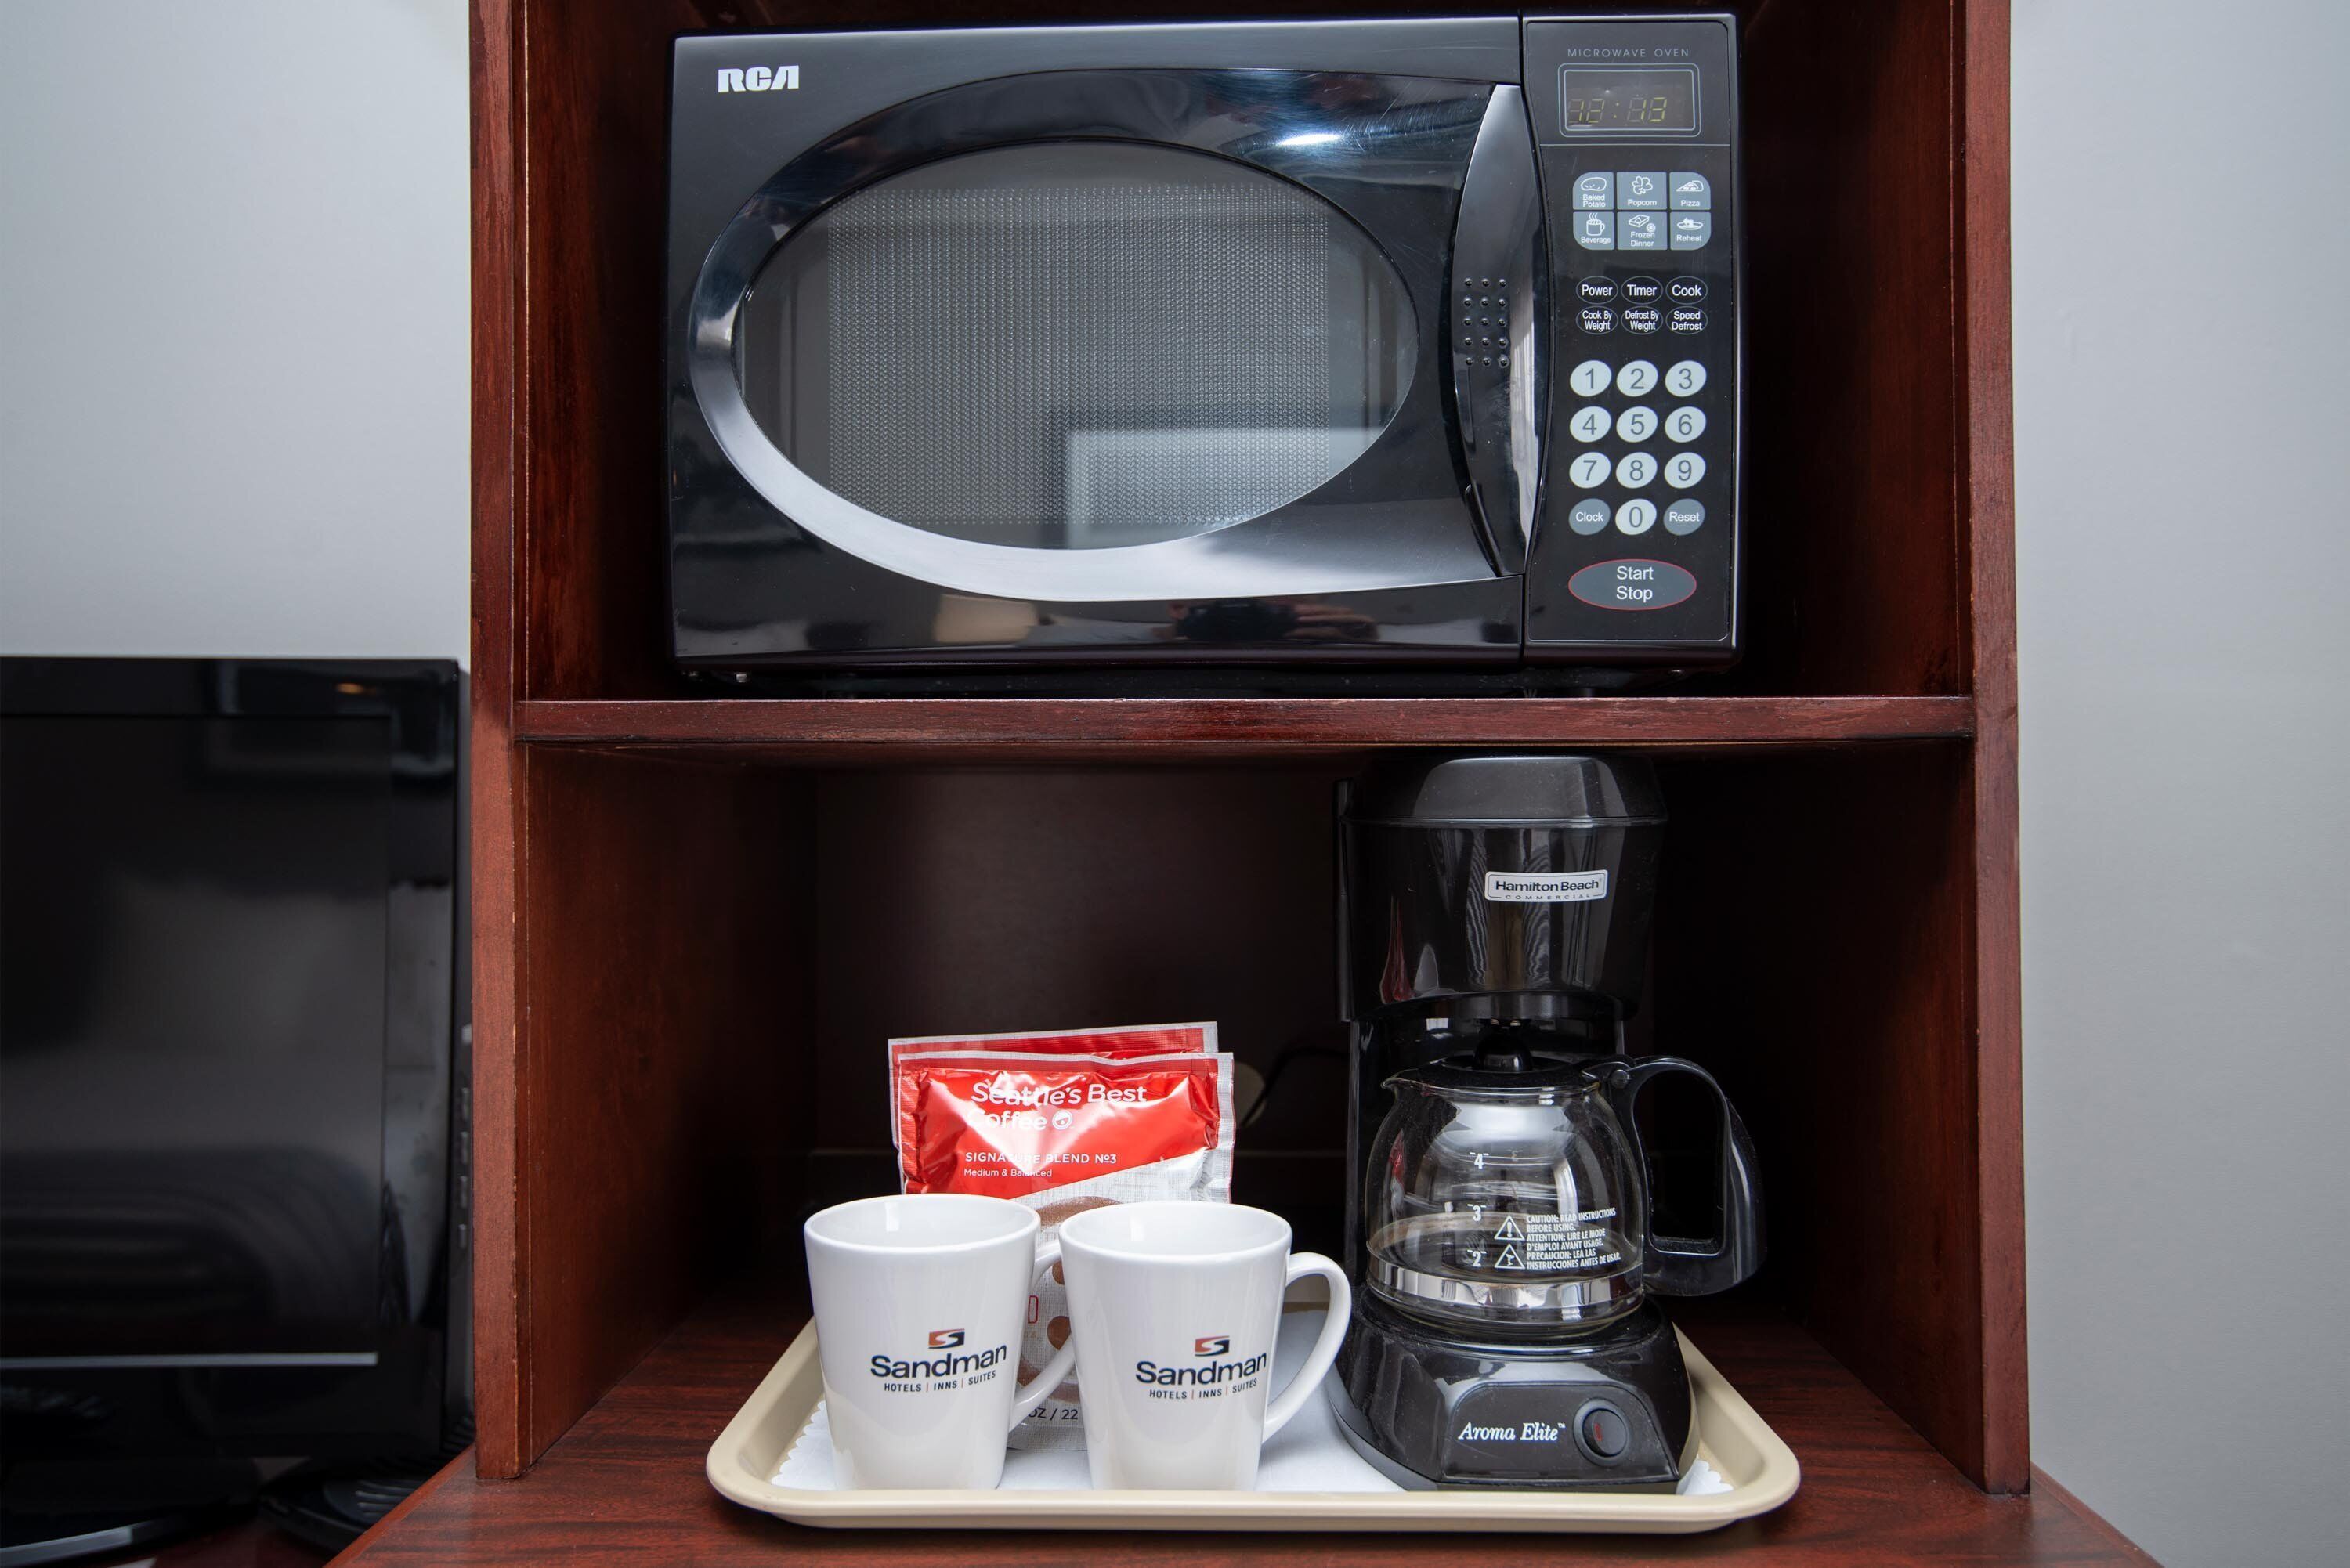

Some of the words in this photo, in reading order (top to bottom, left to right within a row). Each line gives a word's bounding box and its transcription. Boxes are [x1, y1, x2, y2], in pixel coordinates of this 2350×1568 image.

[1567, 49, 1646, 57] MICROWAVE
[1654, 48, 1689, 57] OVEN
[718, 65, 799, 92] RCA
[1627, 199, 1657, 208] Popcorn
[1581, 236, 1611, 244] Beverage
[1582, 284, 1614, 296] Power
[1626, 284, 1658, 296] Timer
[1672, 284, 1702, 296] Cook
[1582, 310, 1602, 320] Cook
[1603, 310, 1612, 320] By
[1625, 310, 1650, 320] Defrost
[1650, 310, 1659, 321] By
[1673, 311, 1701, 321] Speed
[1585, 320, 1611, 332] Weight
[1630, 320, 1656, 332] Weight
[1672, 321, 1703, 331] Defrost
[1585, 368, 1595, 389] 1
[1630, 368, 1644, 389] 2
[1679, 368, 1693, 389] 3
[1582, 414, 1597, 435] 4
[1631, 414, 1645, 435] 5
[1678, 414, 1692, 435] 6
[1583, 461, 1597, 481] 7
[1629, 460, 1643, 481] 8
[1678, 460, 1692, 481] 9
[1575, 511, 1604, 522] Clock
[1629, 506, 1643, 528] 0
[1668, 511, 1700, 522] Reset
[1616, 565, 1654, 580] Start
[1616, 586, 1653, 602] Stop
[1495, 880, 1559, 891] Hamilton
[971, 1082, 1083, 1107] Seattle's
[1087, 1083, 1148, 1104] Best
[968, 1108, 1047, 1131] Coffee
[965, 1152, 1041, 1164] SIGNAURE
[1045, 1154, 1090, 1163] BLEND
[1473, 1153, 1484, 1169] 4
[964, 1168, 1000, 1177] Medium
[1001, 1169, 1008, 1177] &
[1473, 1205, 1481, 1222] 3
[1526, 1215, 1560, 1223] CAUTION:
[1560, 1214, 1578, 1223] READ
[1578, 1207, 1617, 1221] INSTRUCTIONS
[1526, 1233, 1566, 1242] ATTENTION:
[1567, 1231, 1581, 1241] LIRE
[1582, 1230, 1589, 1239] LE
[1589, 1228, 1606, 1238] MODE
[1527, 1223, 1553, 1233] BEFORE
[1553, 1223, 1576, 1232] USING.
[1560, 1241, 1582, 1250] AVANT
[1583, 1238, 1603, 1248] USAGE.
[1472, 1251, 1481, 1267] 2
[1527, 1251, 1572, 1261] PRECAUCION:
[1573, 1249, 1584, 1259] LEA
[1585, 1248, 1596, 1258] LAS
[1527, 1259, 1579, 1270] INSTRUCCIONES
[1580, 1256, 1598, 1267] ANTES
[1599, 1255, 1607, 1265] DE
[870, 1343, 1007, 1378] Sandman
[1135, 1353, 1267, 1386] Sandman
[884, 1383, 922, 1393] HOTELS
[933, 1380, 957, 1391] INNS
[968, 1370, 996, 1386] SUITES
[1149, 1389, 1188, 1400] HOTELS
[1198, 1388, 1223, 1398] INNS
[1231, 1378, 1257, 1393] SUITES
[1061, 1408, 1079, 1420] 22
[1457, 1422, 1516, 1441] Aroma
